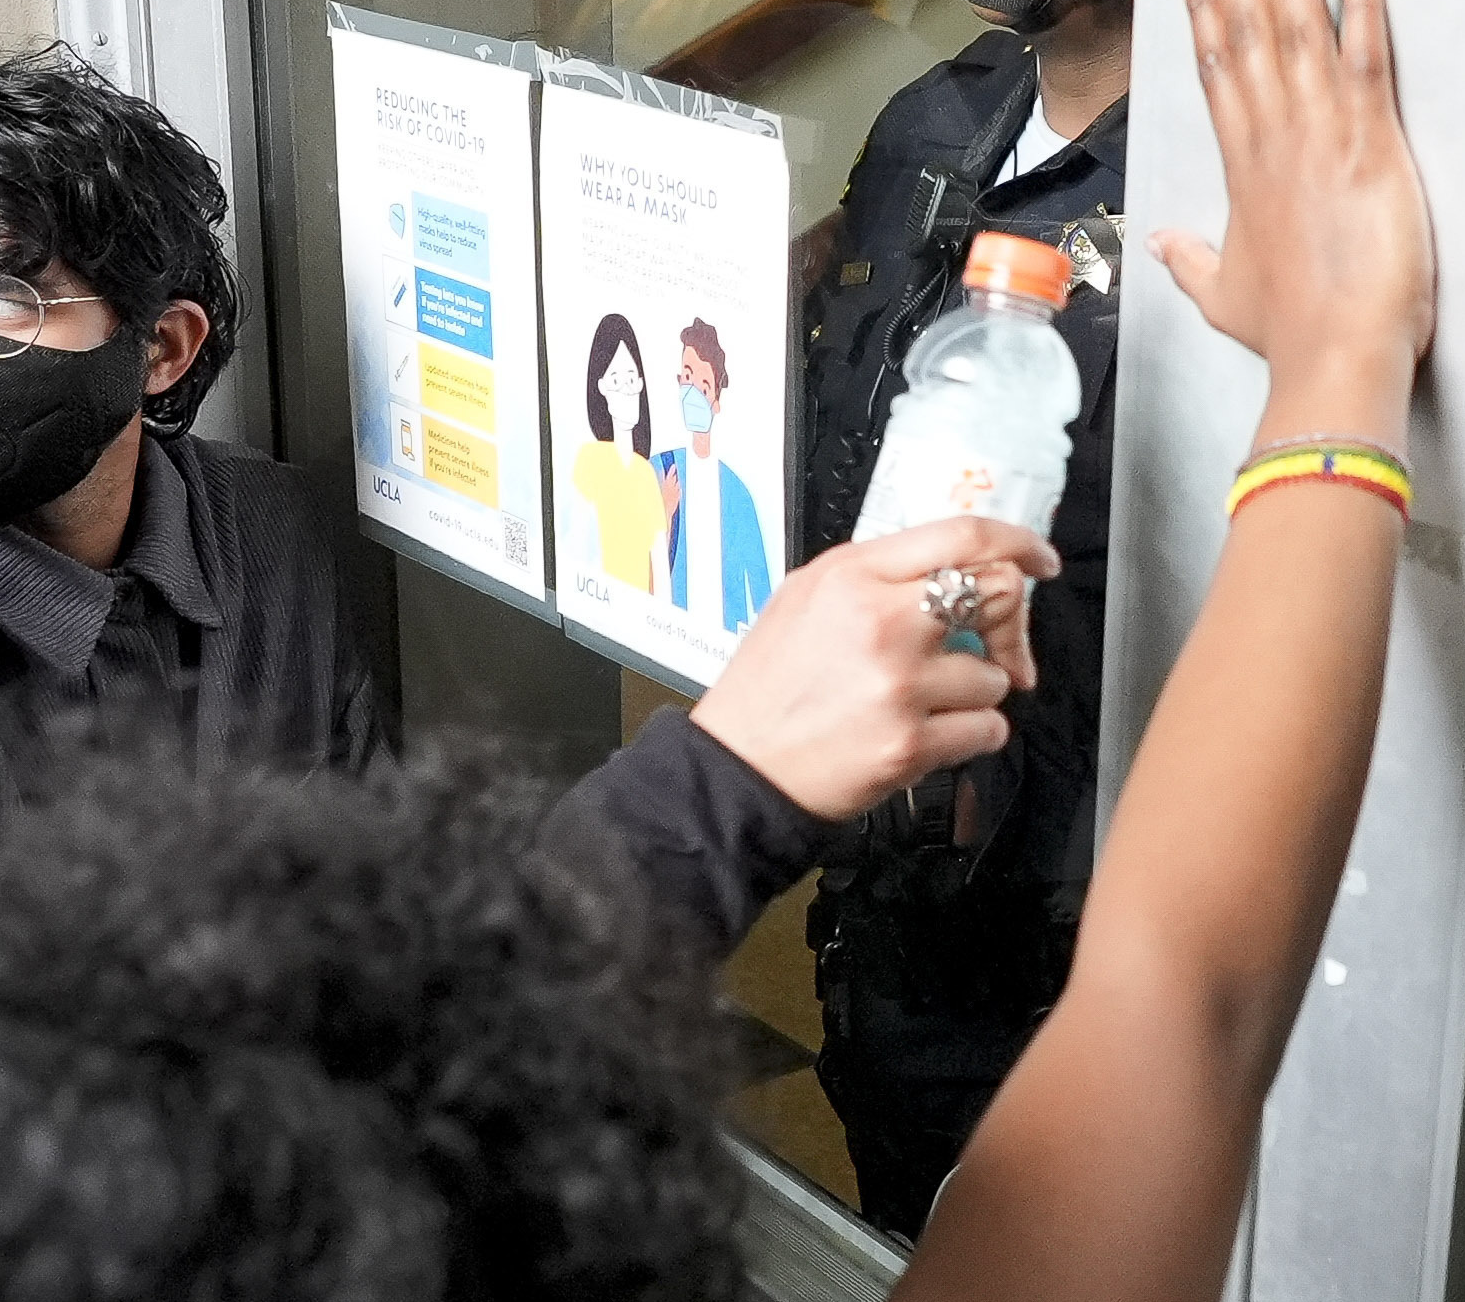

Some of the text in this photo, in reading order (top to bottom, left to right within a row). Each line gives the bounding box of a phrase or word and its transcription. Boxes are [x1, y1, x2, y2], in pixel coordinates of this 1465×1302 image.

[376, 87, 467, 128] REDUCING THE
[377, 109, 485, 155] RISK OF COVID-19
[580, 152, 717, 209] WHY YOU SHOULD
[581, 177, 687, 225] WEAR A MASK
[372, 474, 401, 505] UCLA
[576, 572, 611, 606] UCLA
